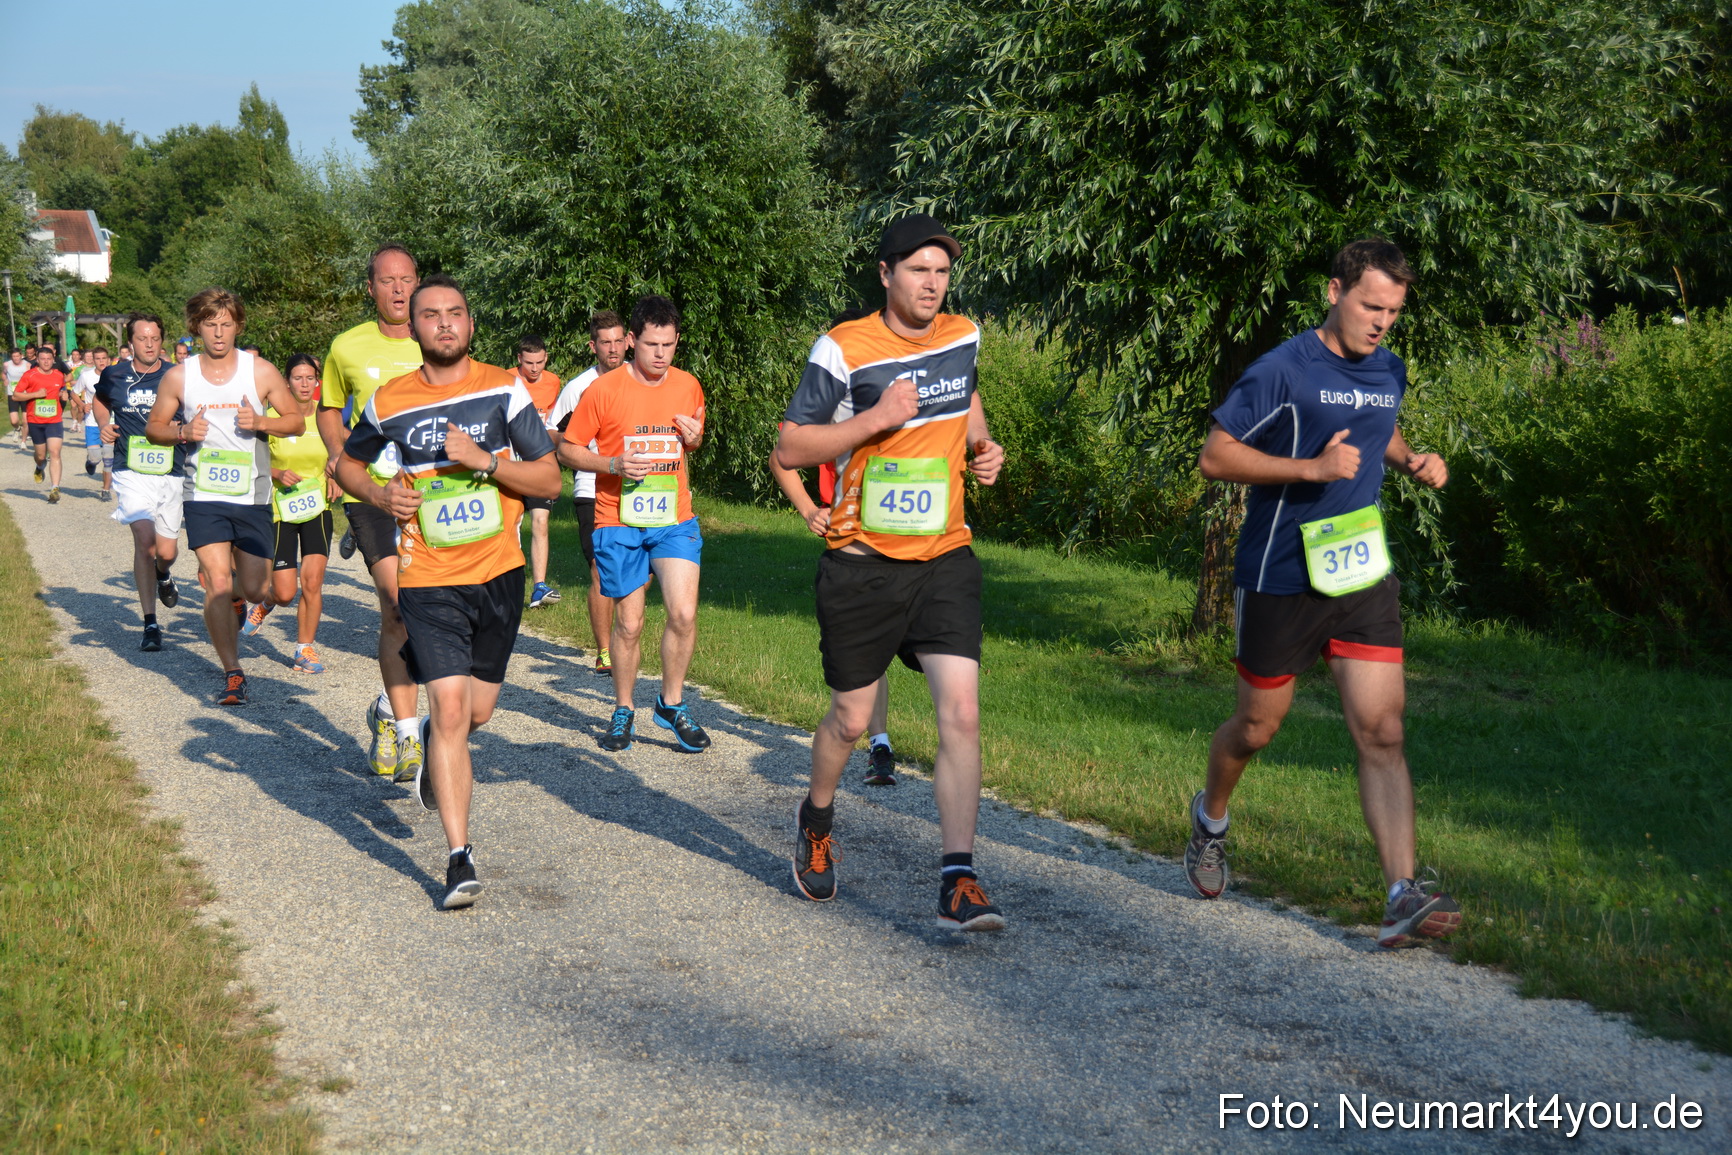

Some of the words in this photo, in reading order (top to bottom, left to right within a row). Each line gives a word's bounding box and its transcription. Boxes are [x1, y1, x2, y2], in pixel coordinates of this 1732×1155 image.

[917, 376, 967, 398] scher
[917, 391, 966, 407] UTOMOBILE
[1364, 394, 1395, 408] POLES
[421, 422, 489, 446] Fisher
[636, 425, 648, 434] 30
[652, 425, 677, 434] Jahre
[629, 440, 679, 454] OBI
[138, 451, 165, 464] 165
[208, 467, 240, 483] 589
[288, 495, 317, 514] 638
[633, 496, 667, 513] 614
[879, 489, 932, 514] 450
[436, 499, 485, 526] 449
[1323, 541, 1370, 575] 379
